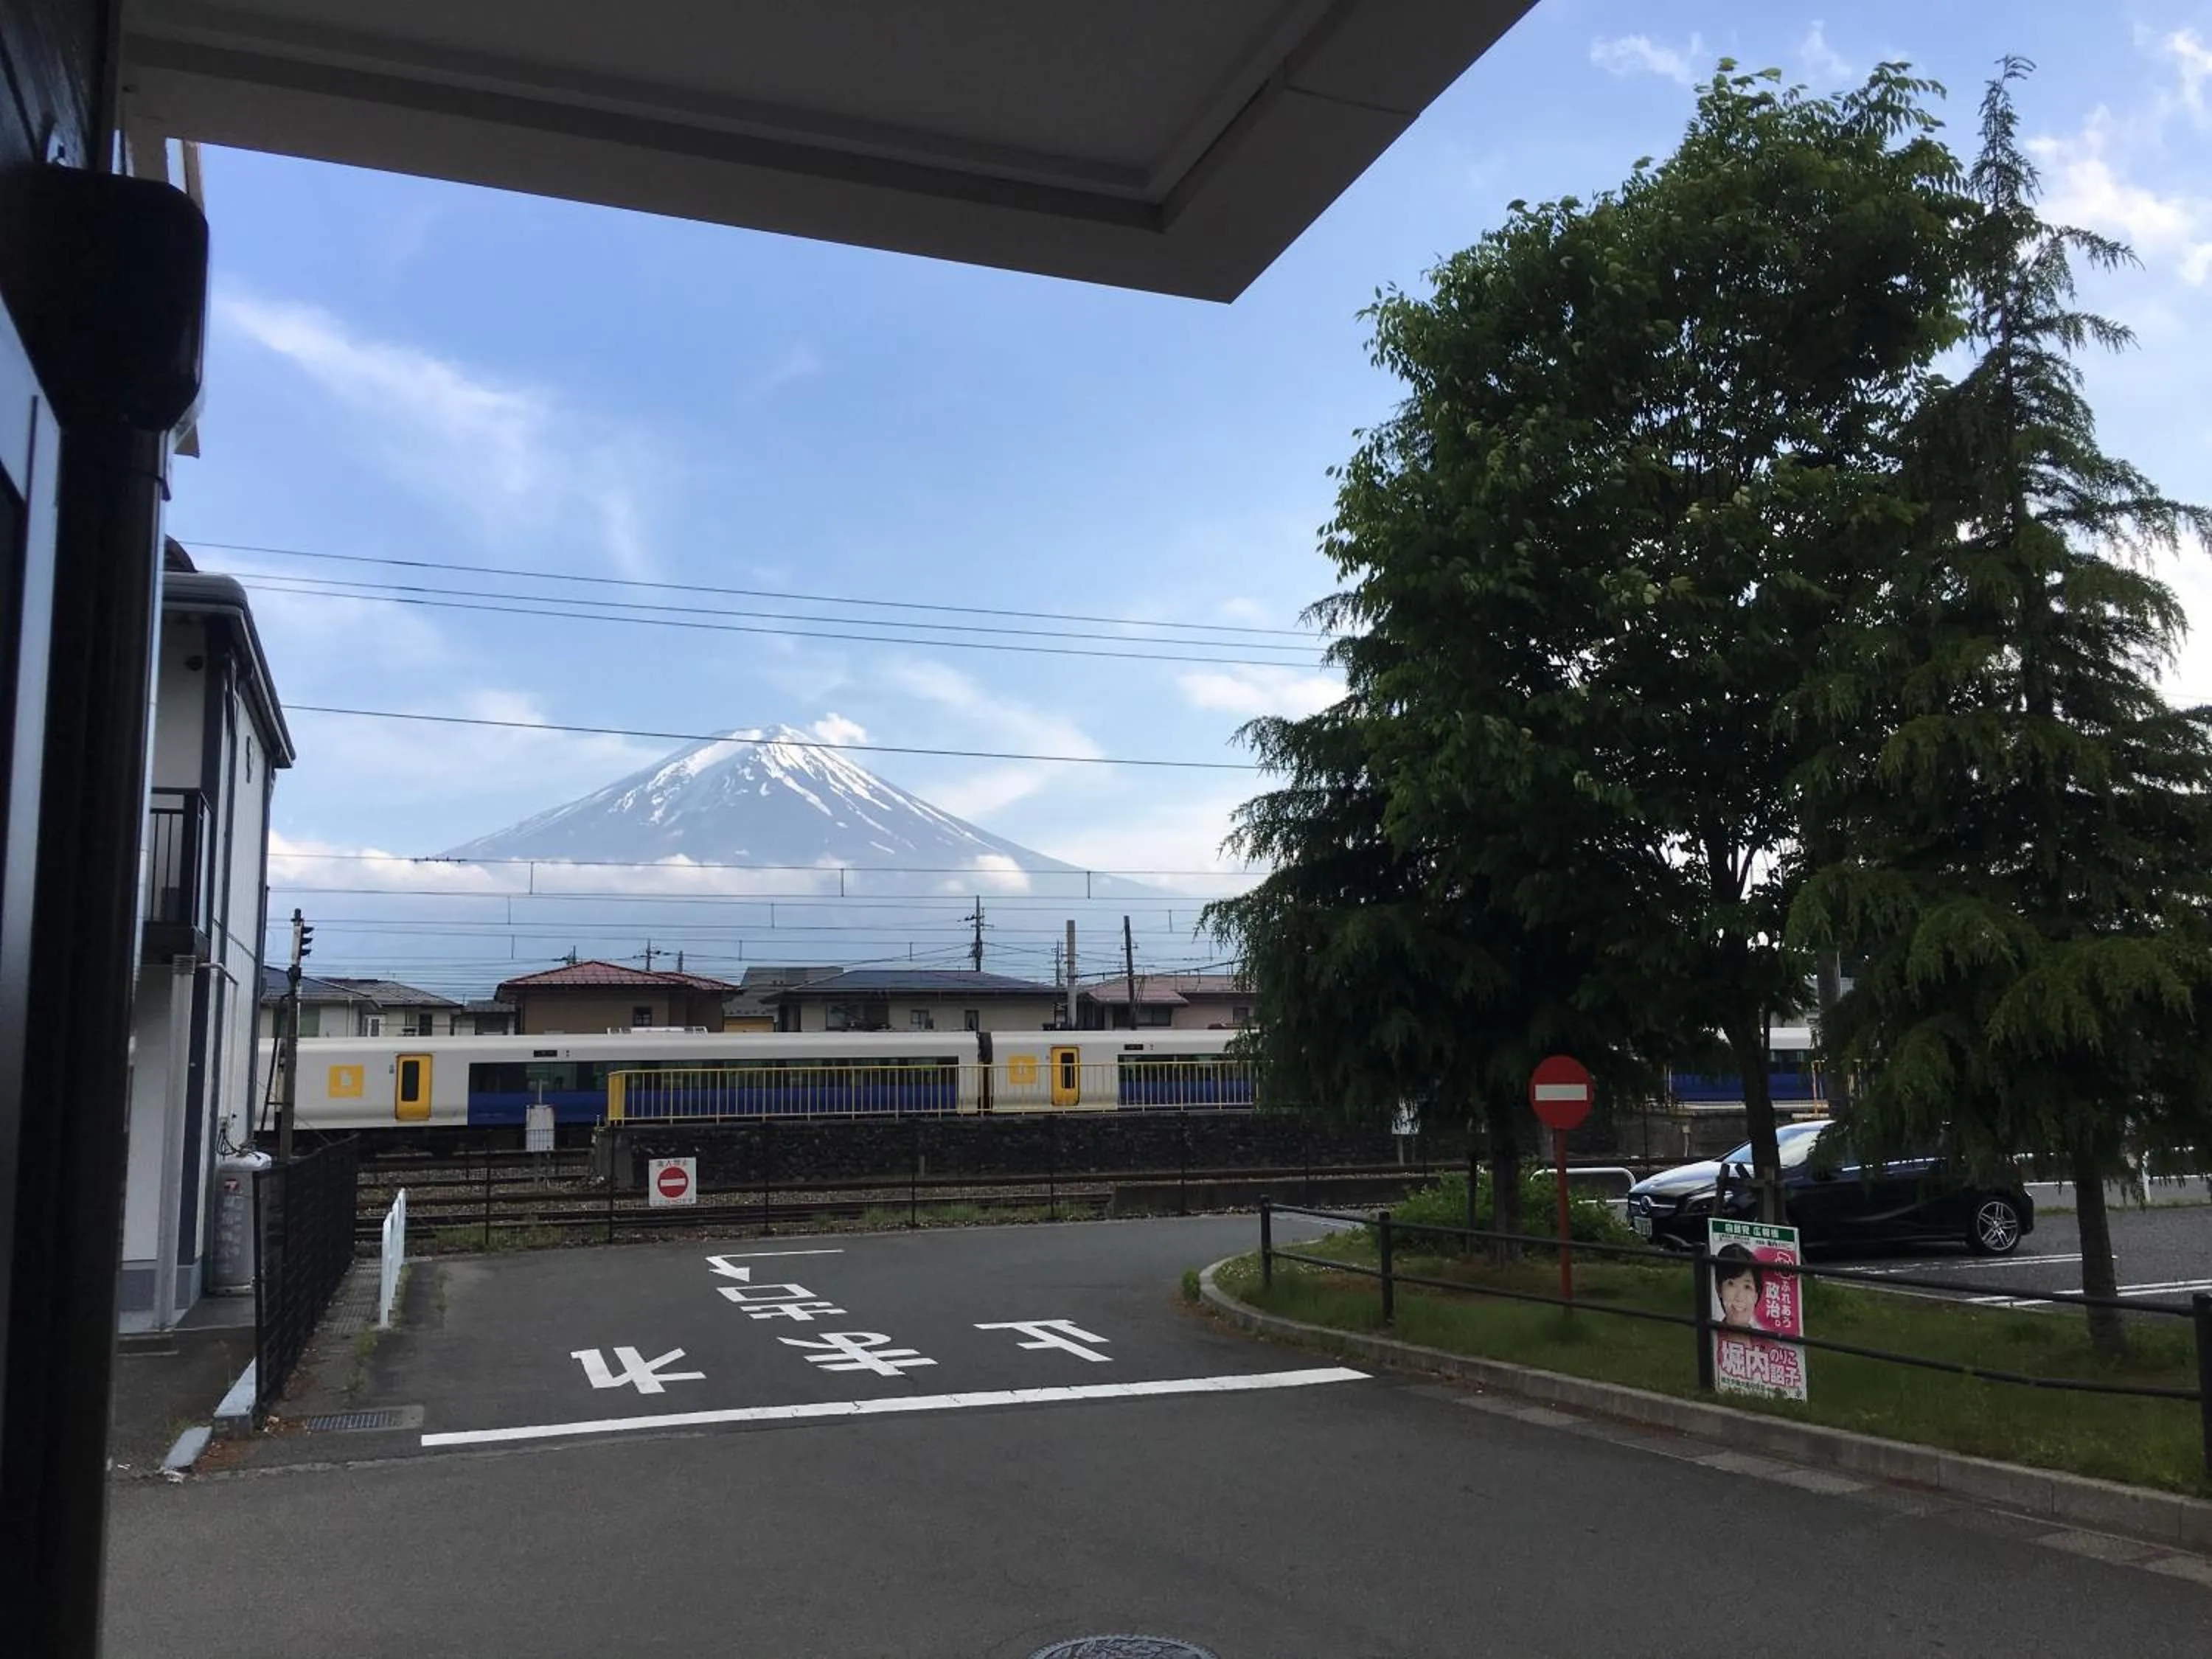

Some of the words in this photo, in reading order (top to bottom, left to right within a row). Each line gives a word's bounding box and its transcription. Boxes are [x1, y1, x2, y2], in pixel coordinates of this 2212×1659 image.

[1722, 1340, 1770, 1382] 堀内
[1770, 1348, 1798, 1366] のりこ
